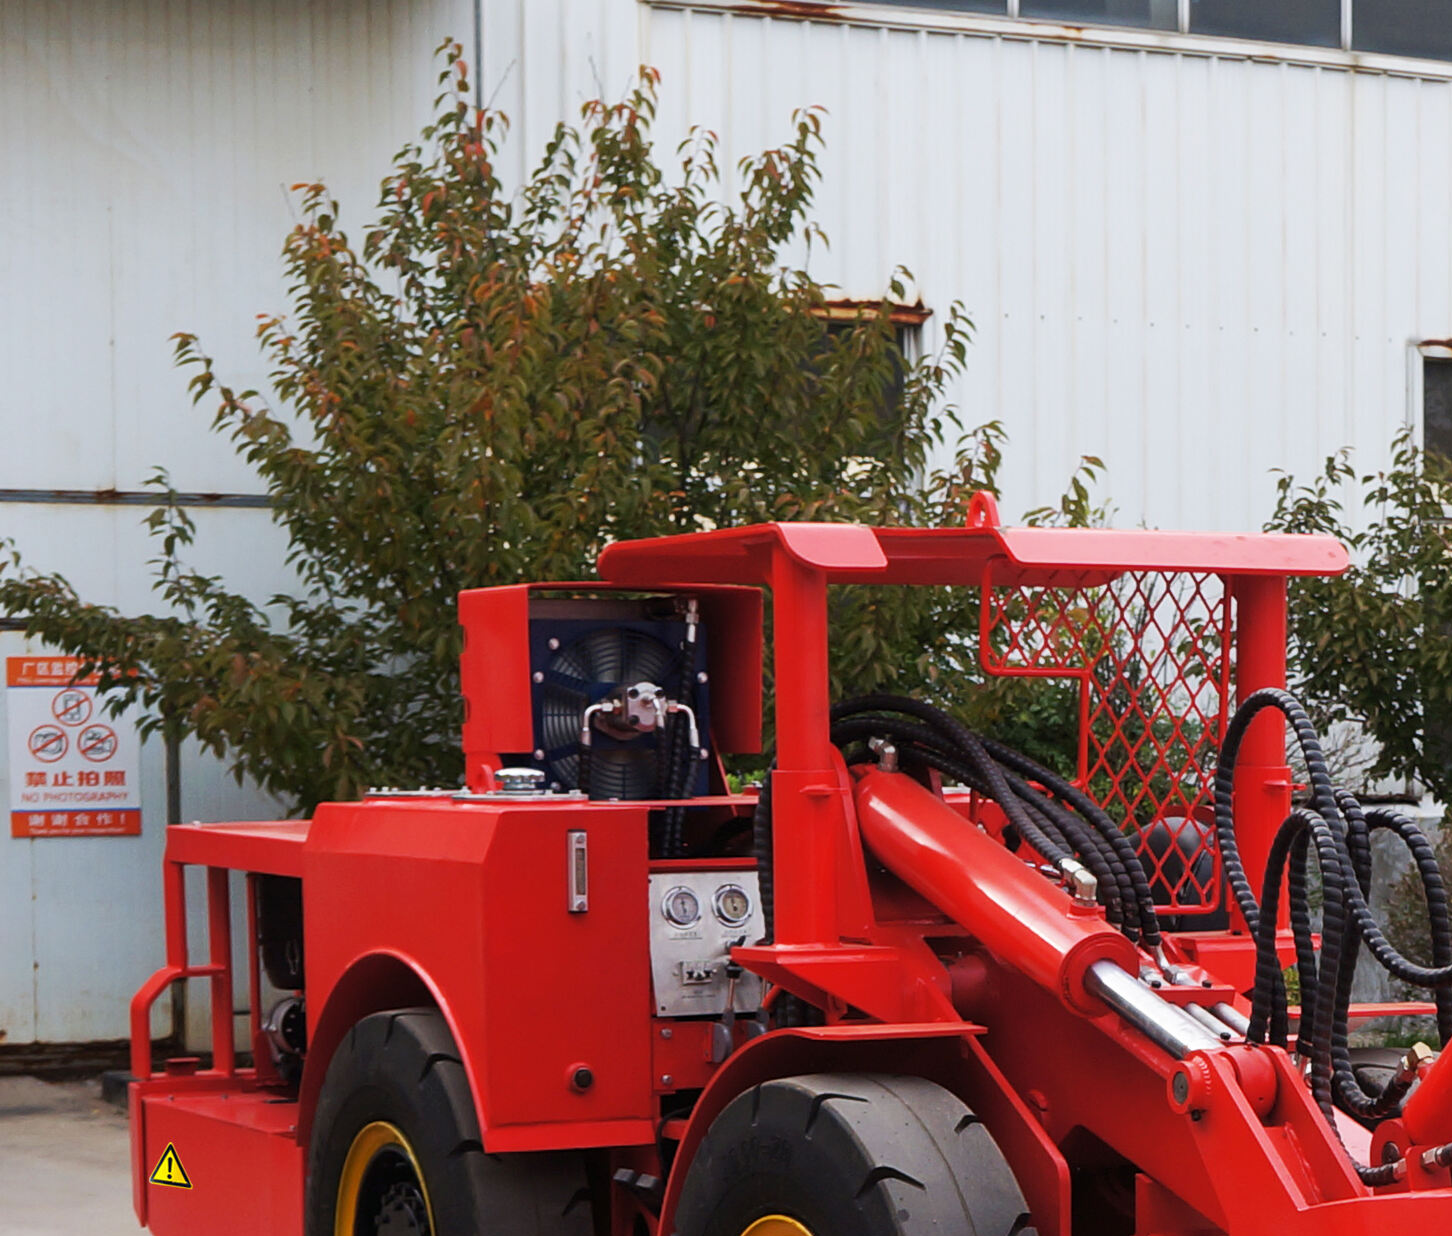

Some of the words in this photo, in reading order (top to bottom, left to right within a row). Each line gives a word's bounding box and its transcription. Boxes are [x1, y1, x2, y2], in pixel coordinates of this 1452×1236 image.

[26, 770, 126, 787] 禁止拍照
[21, 793, 38, 803] NO
[43, 791, 129, 803] PHOTOGRAPHY
